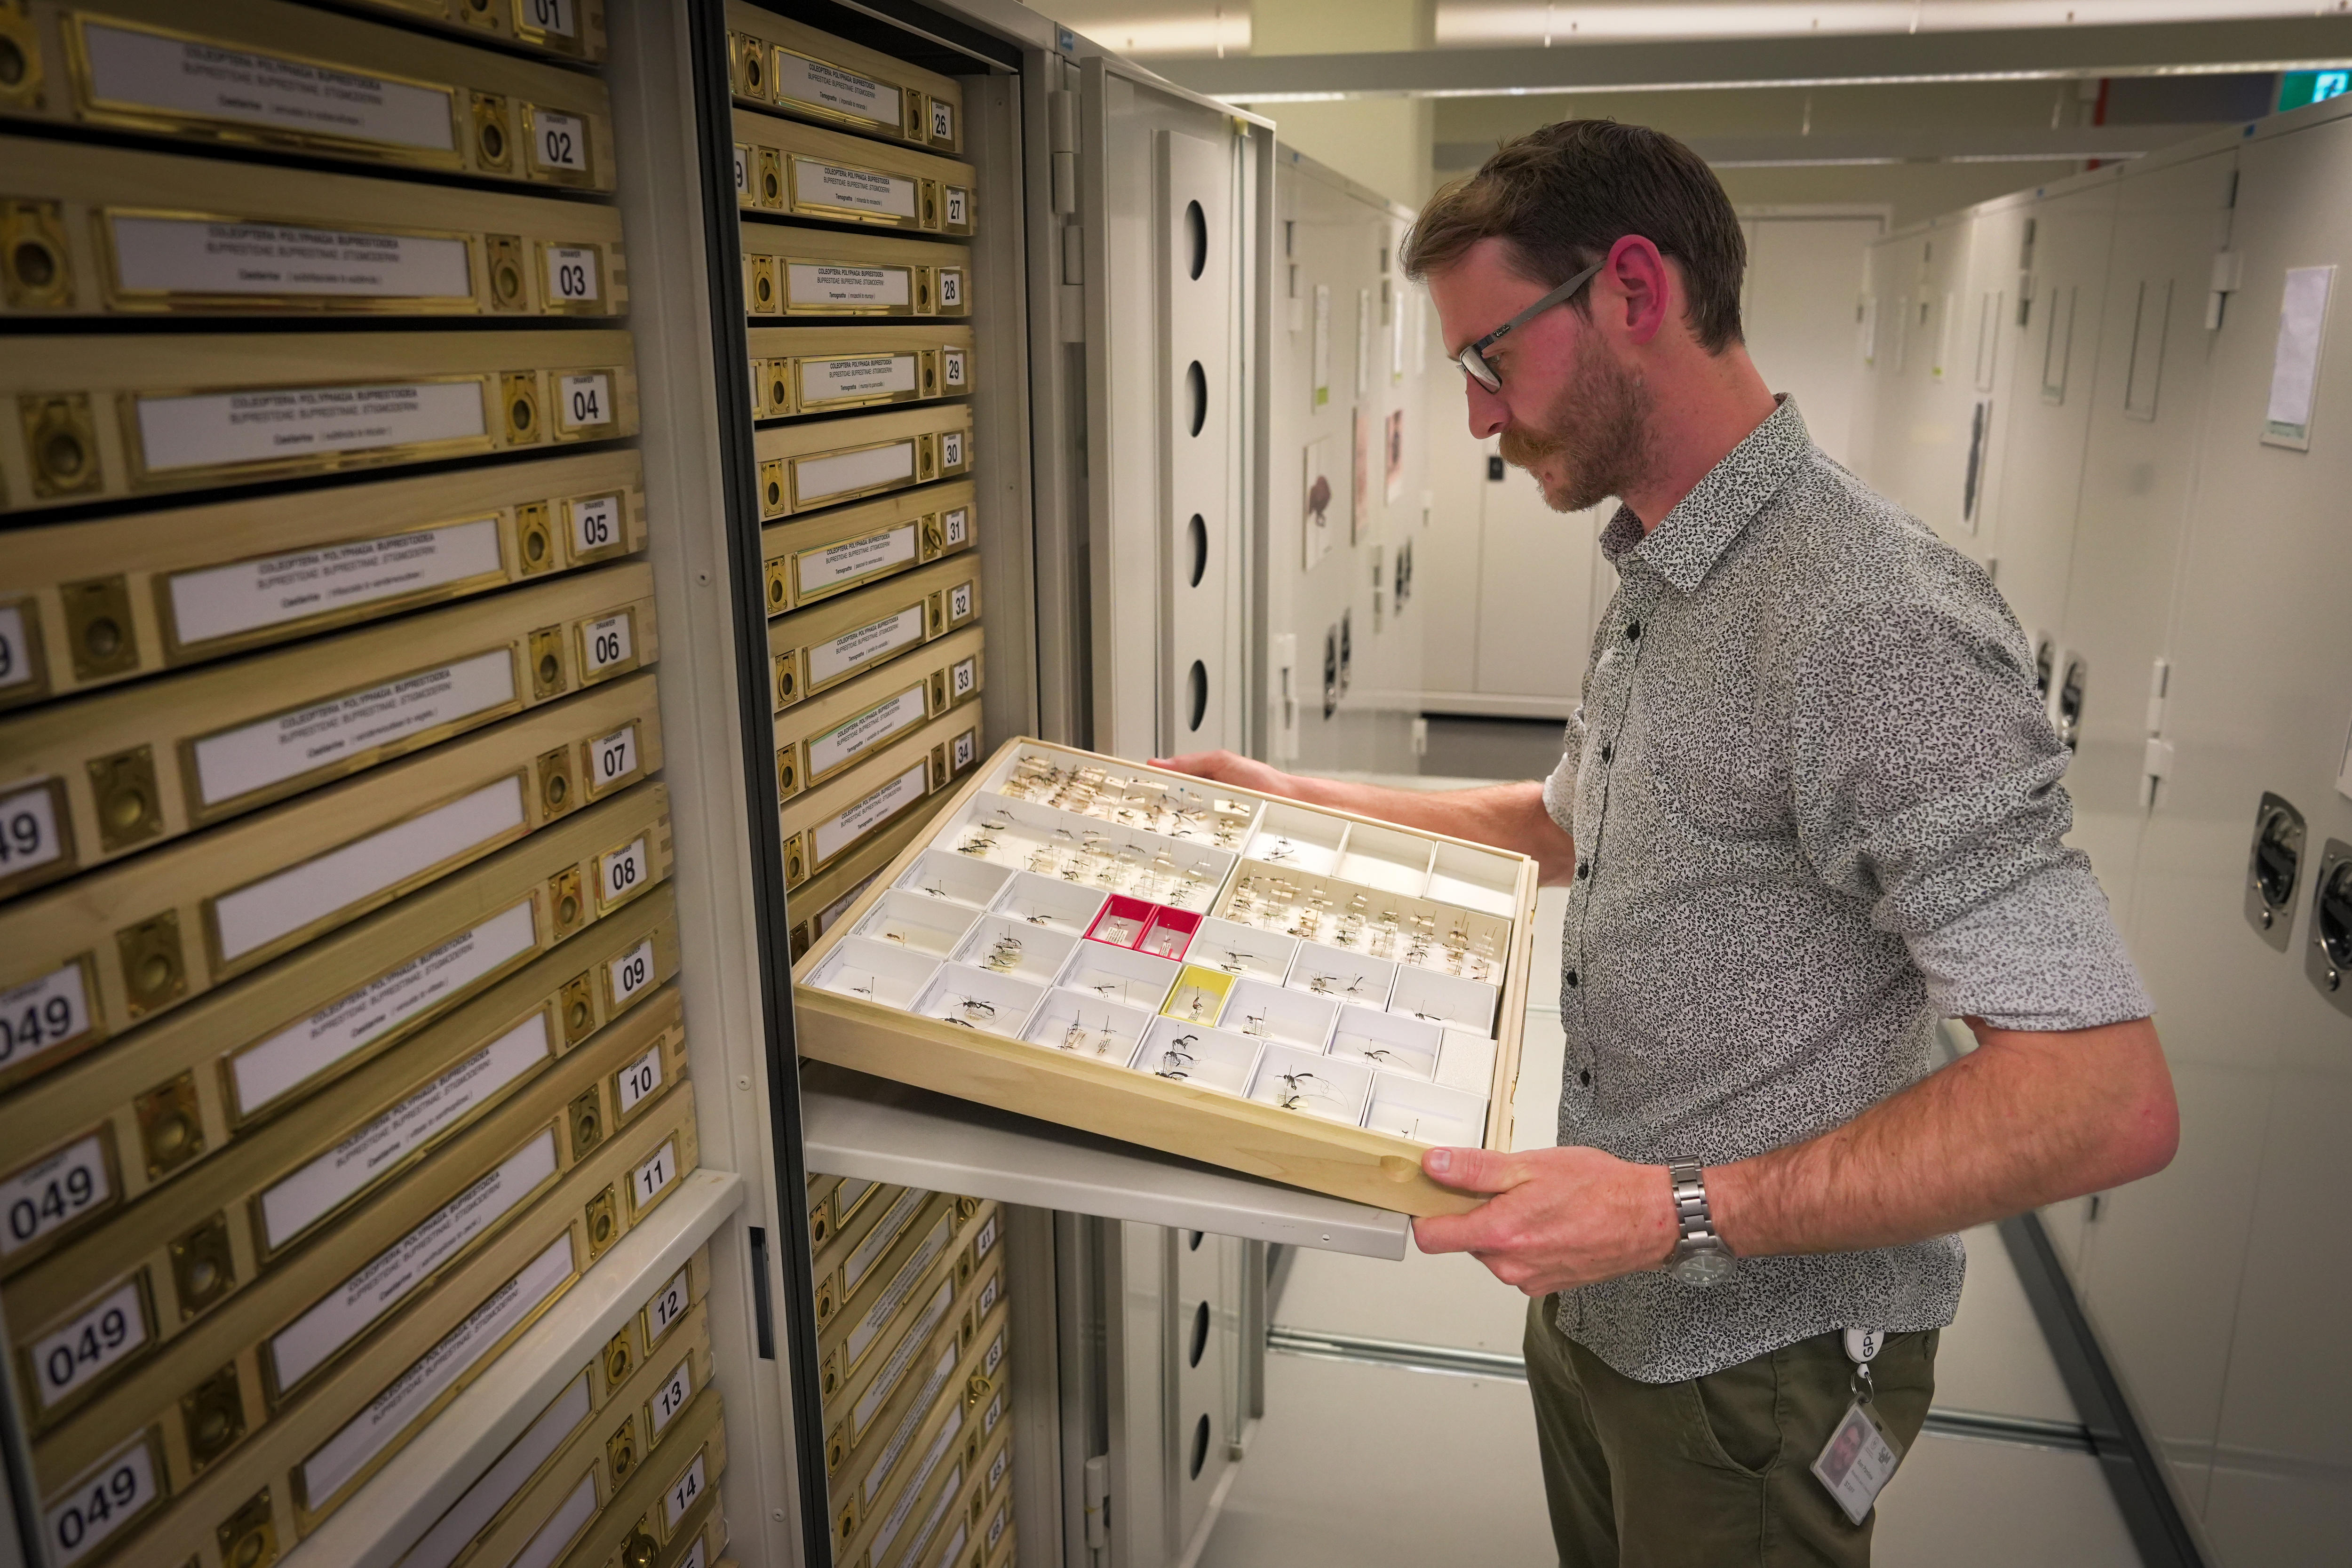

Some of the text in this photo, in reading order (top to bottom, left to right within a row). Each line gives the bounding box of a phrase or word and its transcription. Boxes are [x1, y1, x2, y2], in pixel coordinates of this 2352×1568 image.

[535, 0, 560, 29] 01
[853, 77, 875, 90] BUPRESTOIDEA
[936, 113, 946, 135] 26
[547, 131, 573, 163] 02
[867, 175, 890, 185] BUPRESTOIDEA
[950, 199, 961, 220] 27
[560, 265, 585, 296] 03
[945, 280, 955, 300] 28
[949, 359, 959, 380] 29
[574, 390, 599, 421] 04
[947, 444, 957, 464] 30
[584, 500, 604, 510] DRAWER
[585, 514, 608, 545] 05
[868, 533, 890, 544] BUPRESTOIDEA
[950, 521, 960, 541] 31
[956, 595, 966, 615] 32
[596, 619, 616, 630] DRAWER
[877, 616, 898, 629] BUPRESTOIDEA
[596, 632, 619, 664] 06
[958, 669, 969, 690] 33
[878, 698, 899, 714] BUPRESTOIDEA
[604, 731, 623, 745] DRAWER
[604, 743, 625, 777] 07
[958, 746, 969, 764] 34
[881, 779, 902, 795] BUPRESTOIDEA
[613, 844, 632, 859] DRAWER
[613, 857, 635, 890] 08
[623, 945, 641, 962] DRAWER
[623, 958, 644, 992] 09
[630, 1054, 648, 1072] DRAWER
[630, 1066, 652, 1099] 10
[644, 1160, 663, 1194] 11
[10, 1165, 93, 1241] 049
[982, 1228, 990, 1248] 41
[658, 1290, 678, 1325] 12
[48, 1306, 126, 1388] 049
[662, 1381, 682, 1416] 13
[676, 1466, 692, 1487] DRAWER
[676, 1473, 696, 1510] 14
[58, 1466, 136, 1550] 049
